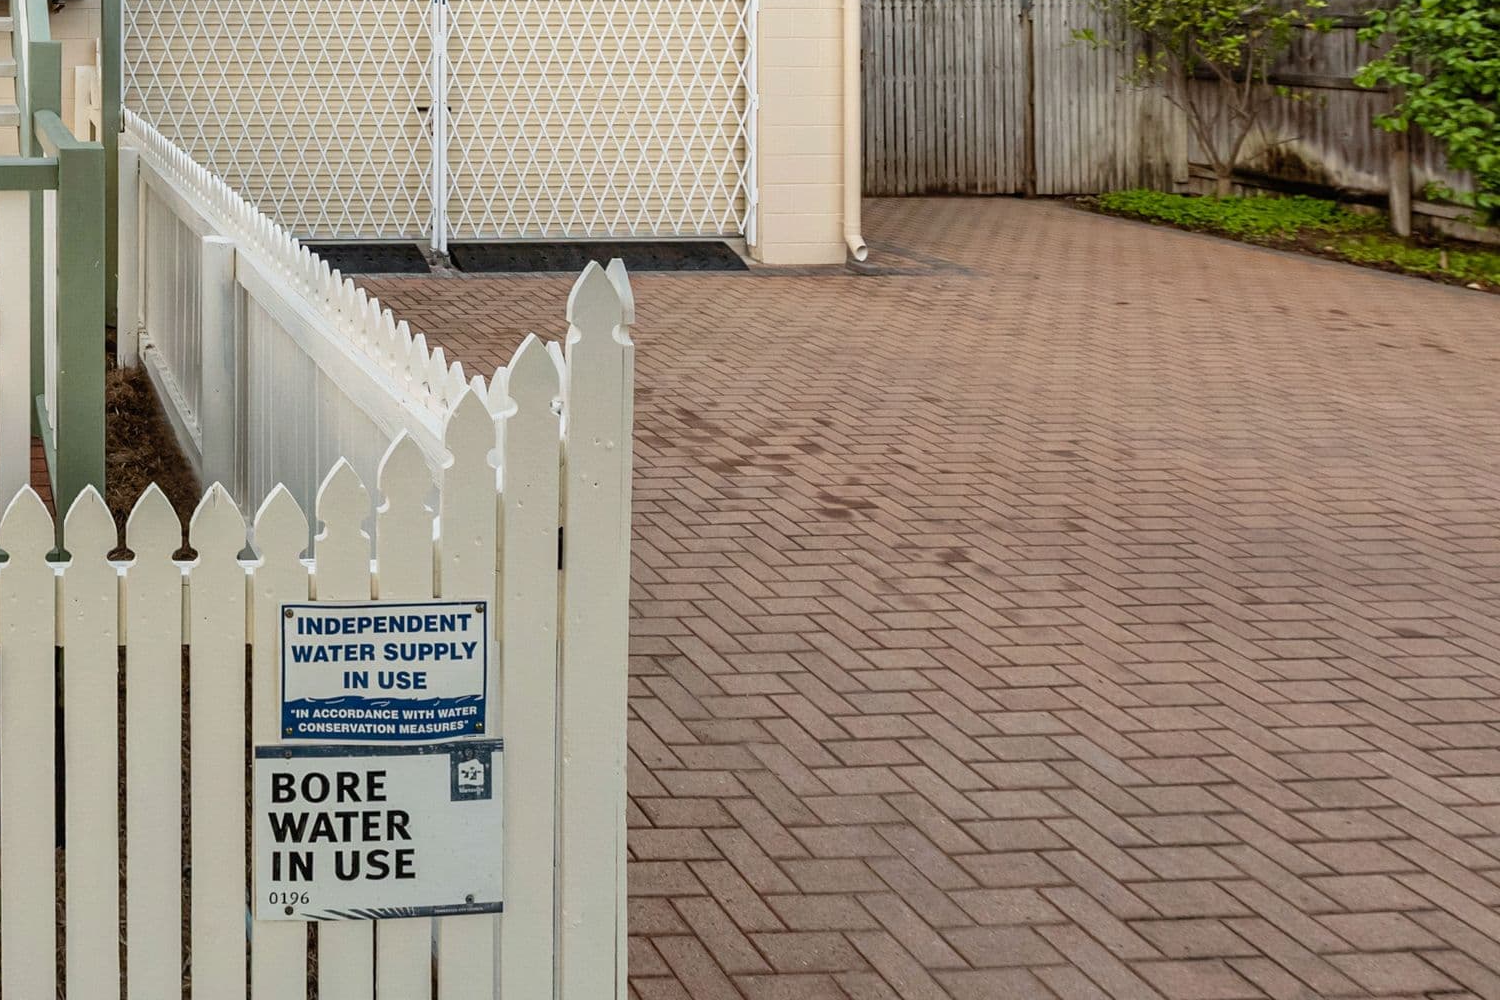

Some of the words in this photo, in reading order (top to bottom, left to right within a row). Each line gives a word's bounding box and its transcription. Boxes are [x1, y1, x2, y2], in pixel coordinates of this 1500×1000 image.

[297, 613, 472, 635] INDEPENDENT
[291, 643, 375, 663] WATER
[383, 641, 478, 661] SUPPLY
[343, 671, 369, 689] IN
[378, 671, 427, 690] USE
[312, 708, 399, 720] ACCORDANCE
[402, 708, 435, 720] WITH
[437, 706, 478, 718] WATER
[298, 722, 397, 734] CONSERVATION
[399, 720, 469, 734] MEASURES"
[271, 770, 387, 804] BORE
[267, 809, 412, 844] WATER
[271, 850, 314, 882] IN
[334, 848, 417, 881] USE
[268, 891, 310, 905] 0196
